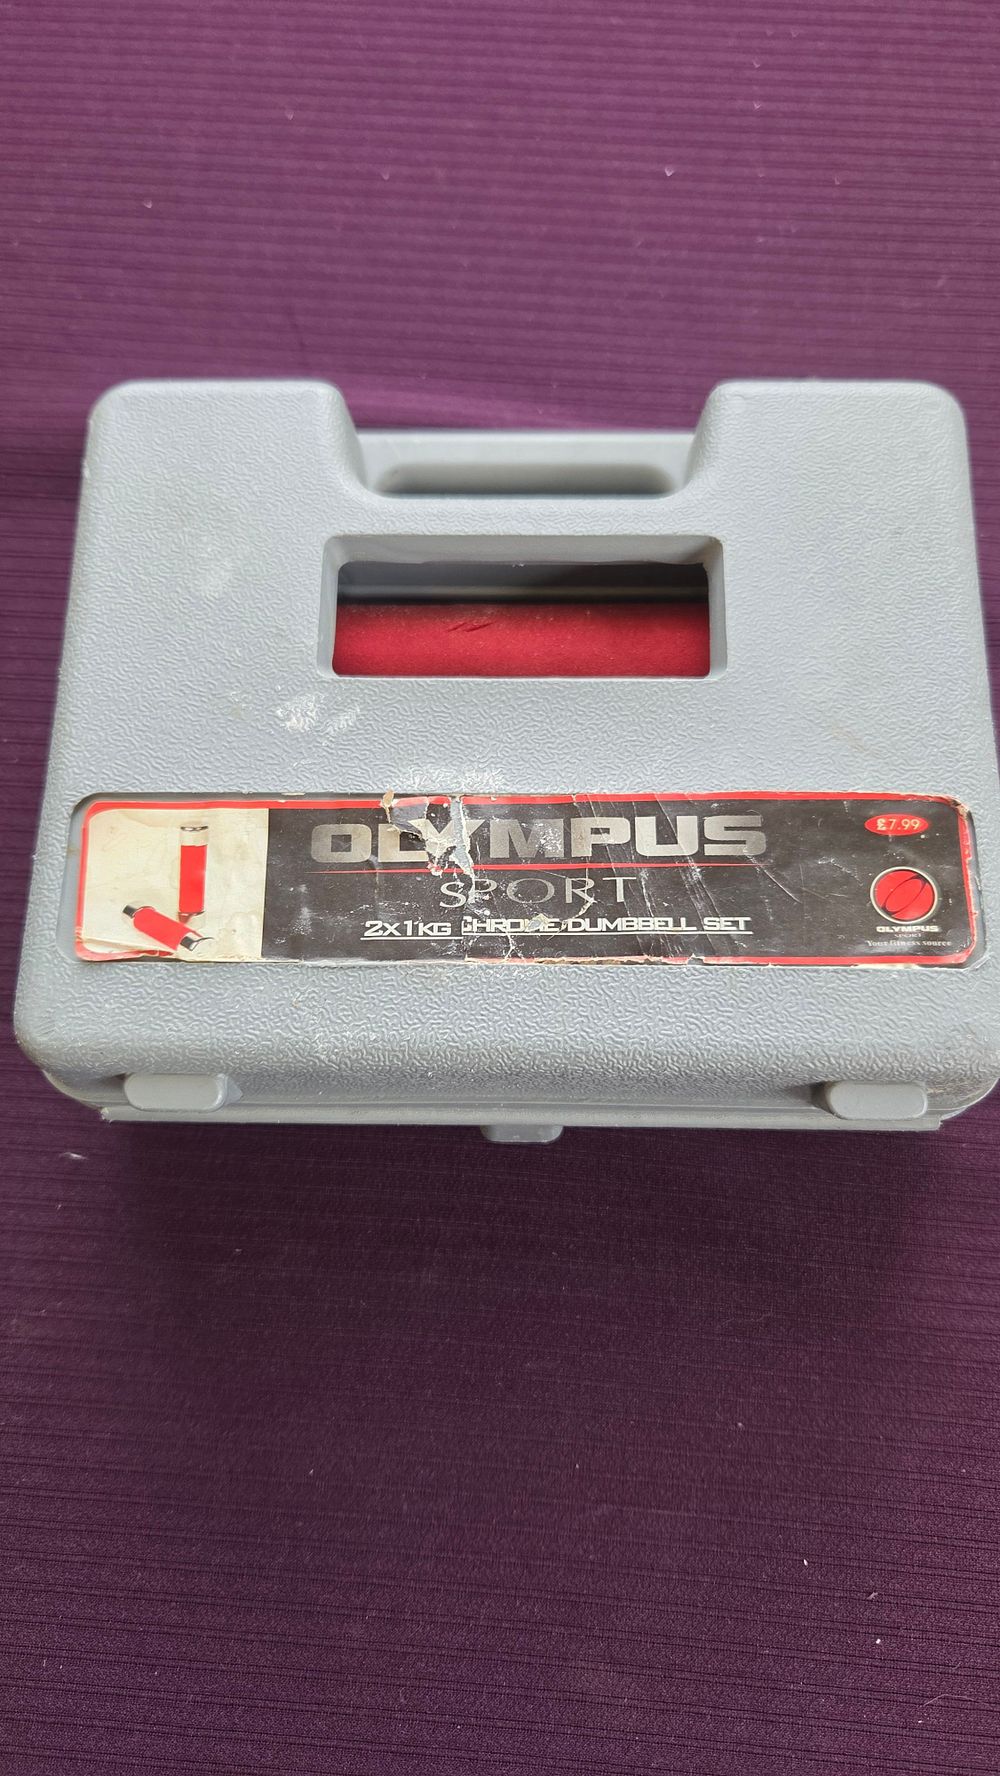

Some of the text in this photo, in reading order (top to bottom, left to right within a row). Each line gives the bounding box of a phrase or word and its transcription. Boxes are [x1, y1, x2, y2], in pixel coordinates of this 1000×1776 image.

[876, 818, 920, 831] £7.99
[310, 815, 767, 863] OLYMPUS
[439, 876, 637, 908] SPORT
[567, 916, 697, 932] DUMBBELL
[703, 916, 752, 931] SET
[876, 925, 940, 933] OLYMPUS
